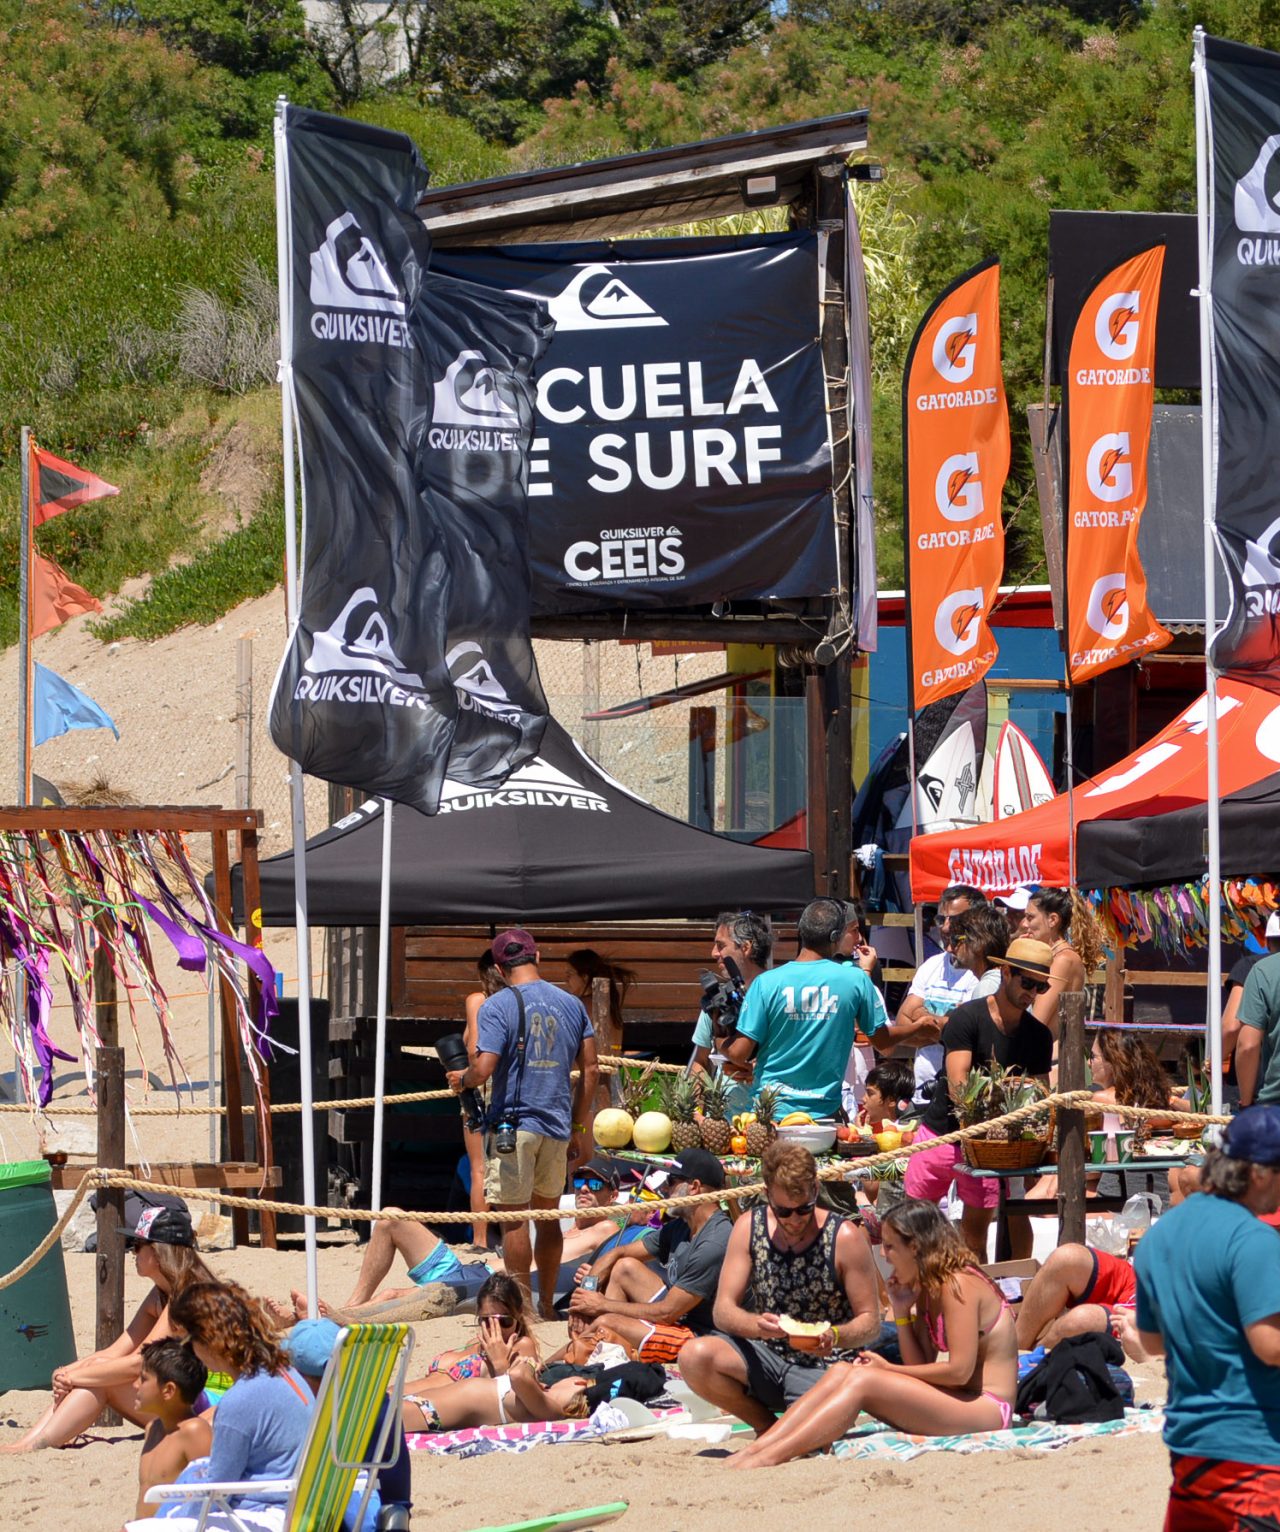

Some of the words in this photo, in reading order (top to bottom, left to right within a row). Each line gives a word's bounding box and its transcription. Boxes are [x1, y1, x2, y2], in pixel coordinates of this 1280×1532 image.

[535, 359, 780, 424] CUELA
[1076, 367, 1151, 386] GATORADE
[916, 387, 997, 412] GATORADE
[587, 425, 782, 494] SURF
[600, 526, 665, 540] QUIKSILVER
[917, 522, 995, 550] GATORADE
[563, 537, 686, 582] CEEIS
[294, 674, 431, 710] QUIKSILVER
[947, 843, 1043, 892] GATORADE
[781, 985, 839, 1014] 10k
